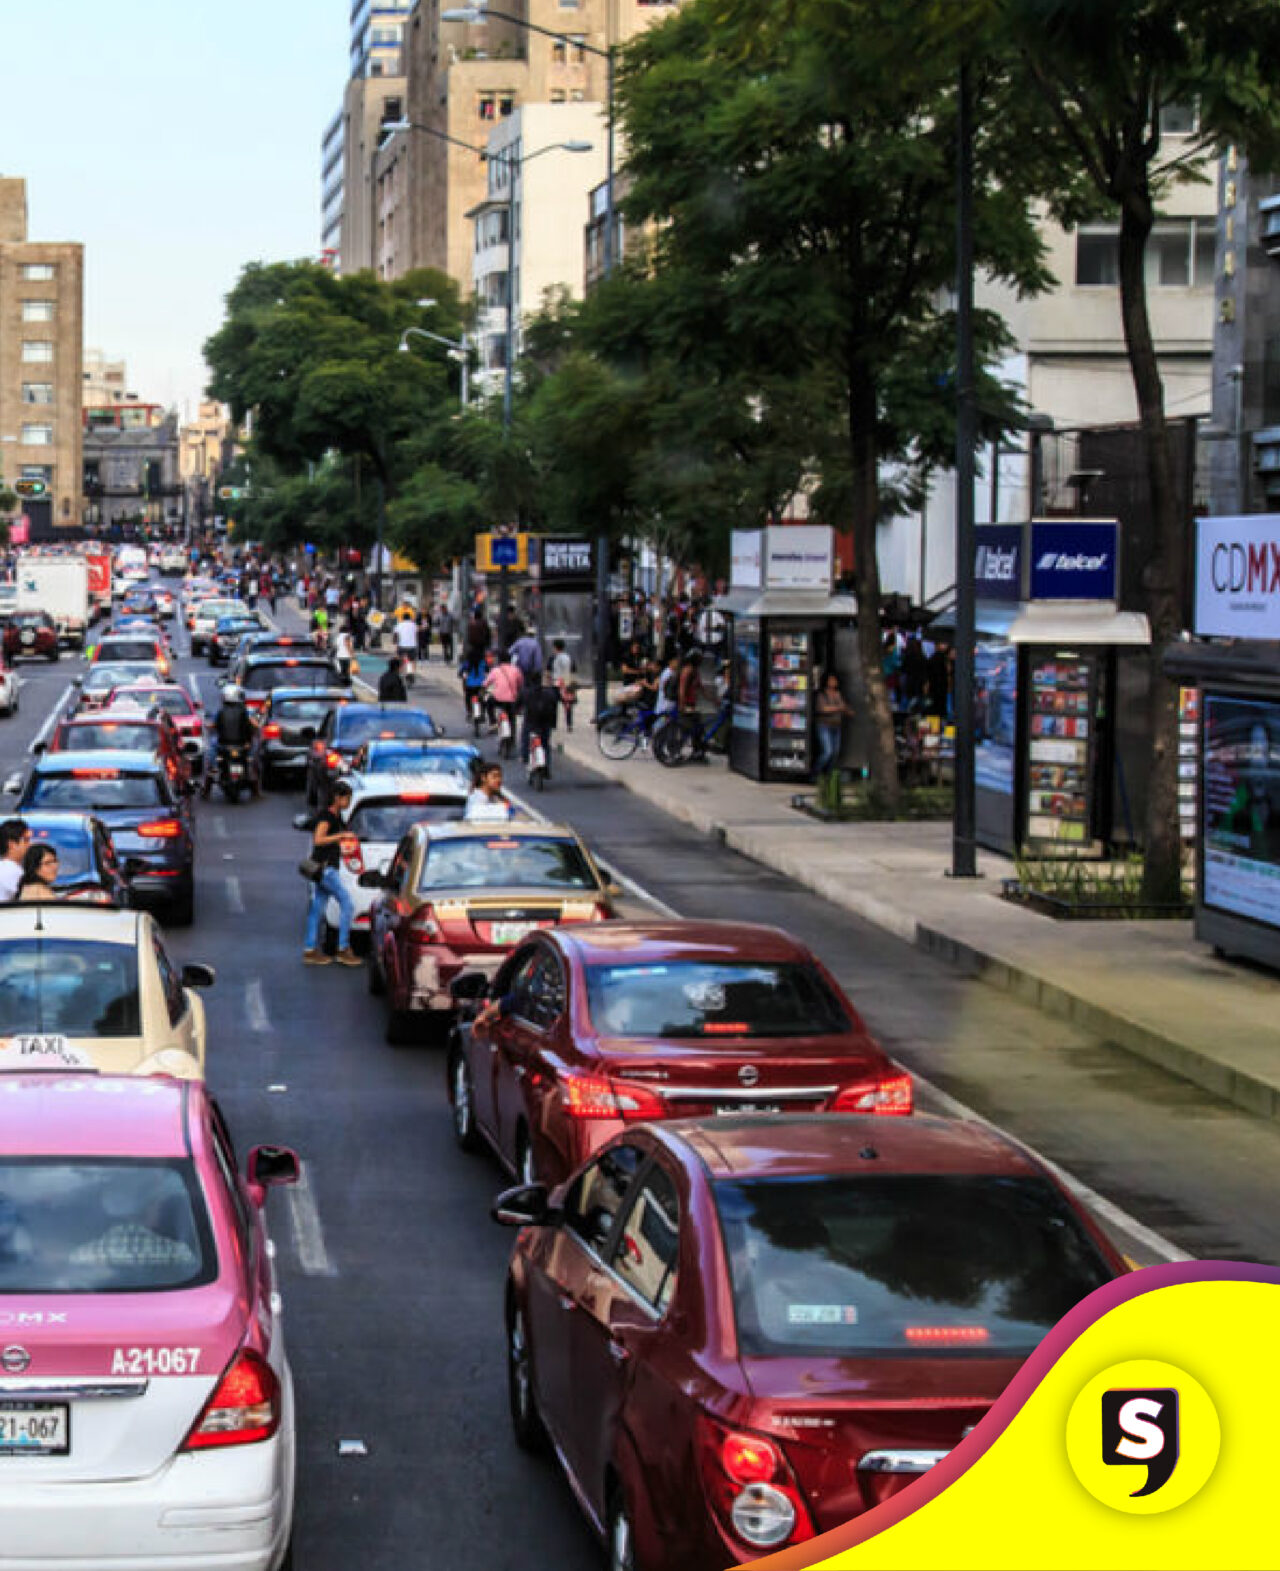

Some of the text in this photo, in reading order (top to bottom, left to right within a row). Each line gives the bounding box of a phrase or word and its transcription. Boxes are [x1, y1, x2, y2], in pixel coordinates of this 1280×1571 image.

[1054, 552, 1109, 570] telcel
[18, 1037, 63, 1054] TAXI
[111, 1348, 201, 1374] A-21-067
